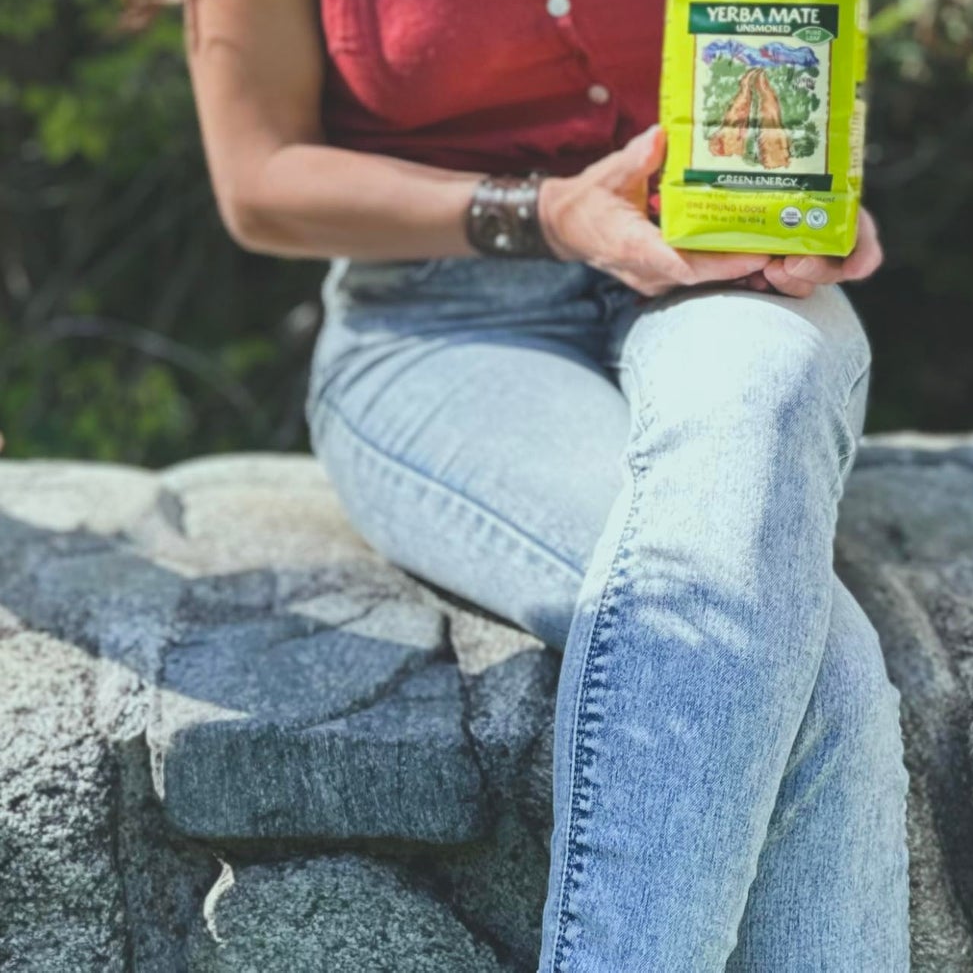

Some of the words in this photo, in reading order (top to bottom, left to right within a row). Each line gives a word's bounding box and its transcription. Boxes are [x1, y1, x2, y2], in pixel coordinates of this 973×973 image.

[706, 6, 764, 23] YERBA
[767, 7, 820, 24] MATE
[736, 24, 792, 34] UNSMOKED
[717, 174, 753, 185] GREEN
[755, 176, 798, 187] ENERGY
[706, 202, 737, 213] POUND
[739, 204, 768, 214] LOOSE
